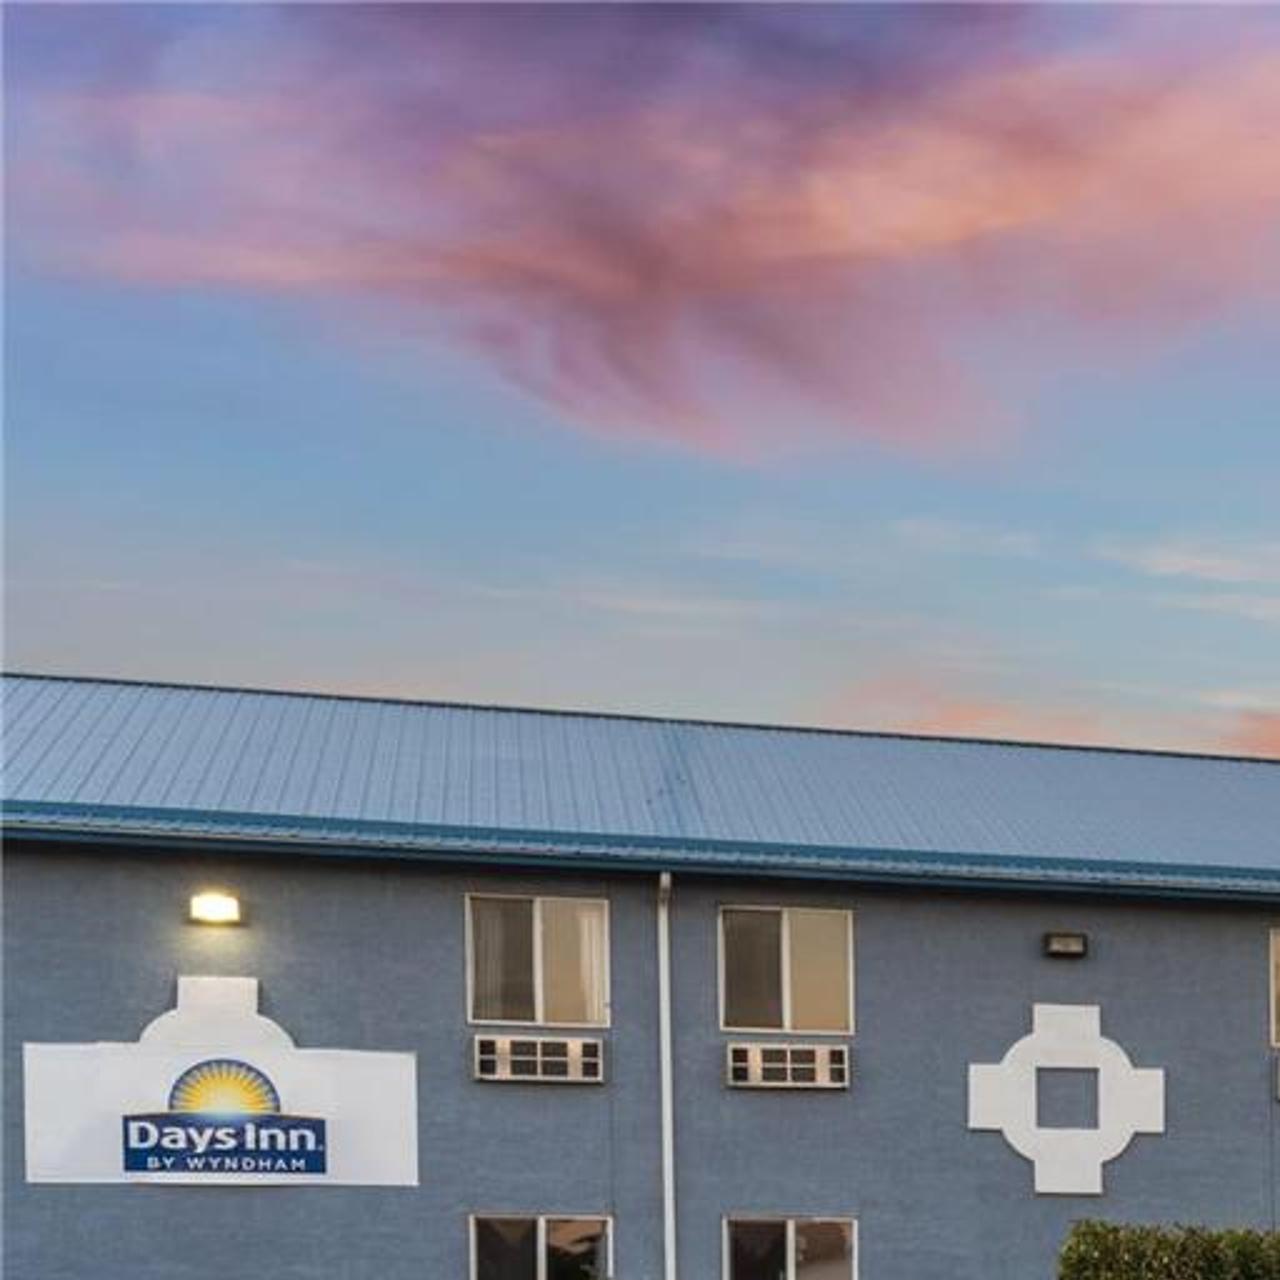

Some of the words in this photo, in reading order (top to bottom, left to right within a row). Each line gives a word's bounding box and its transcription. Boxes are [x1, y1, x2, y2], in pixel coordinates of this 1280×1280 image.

[127, 1121, 238, 1153] Days
[244, 1122, 316, 1151] Inn
[146, 1157, 175, 1169] BY
[187, 1157, 306, 1171] WYNDHAM
